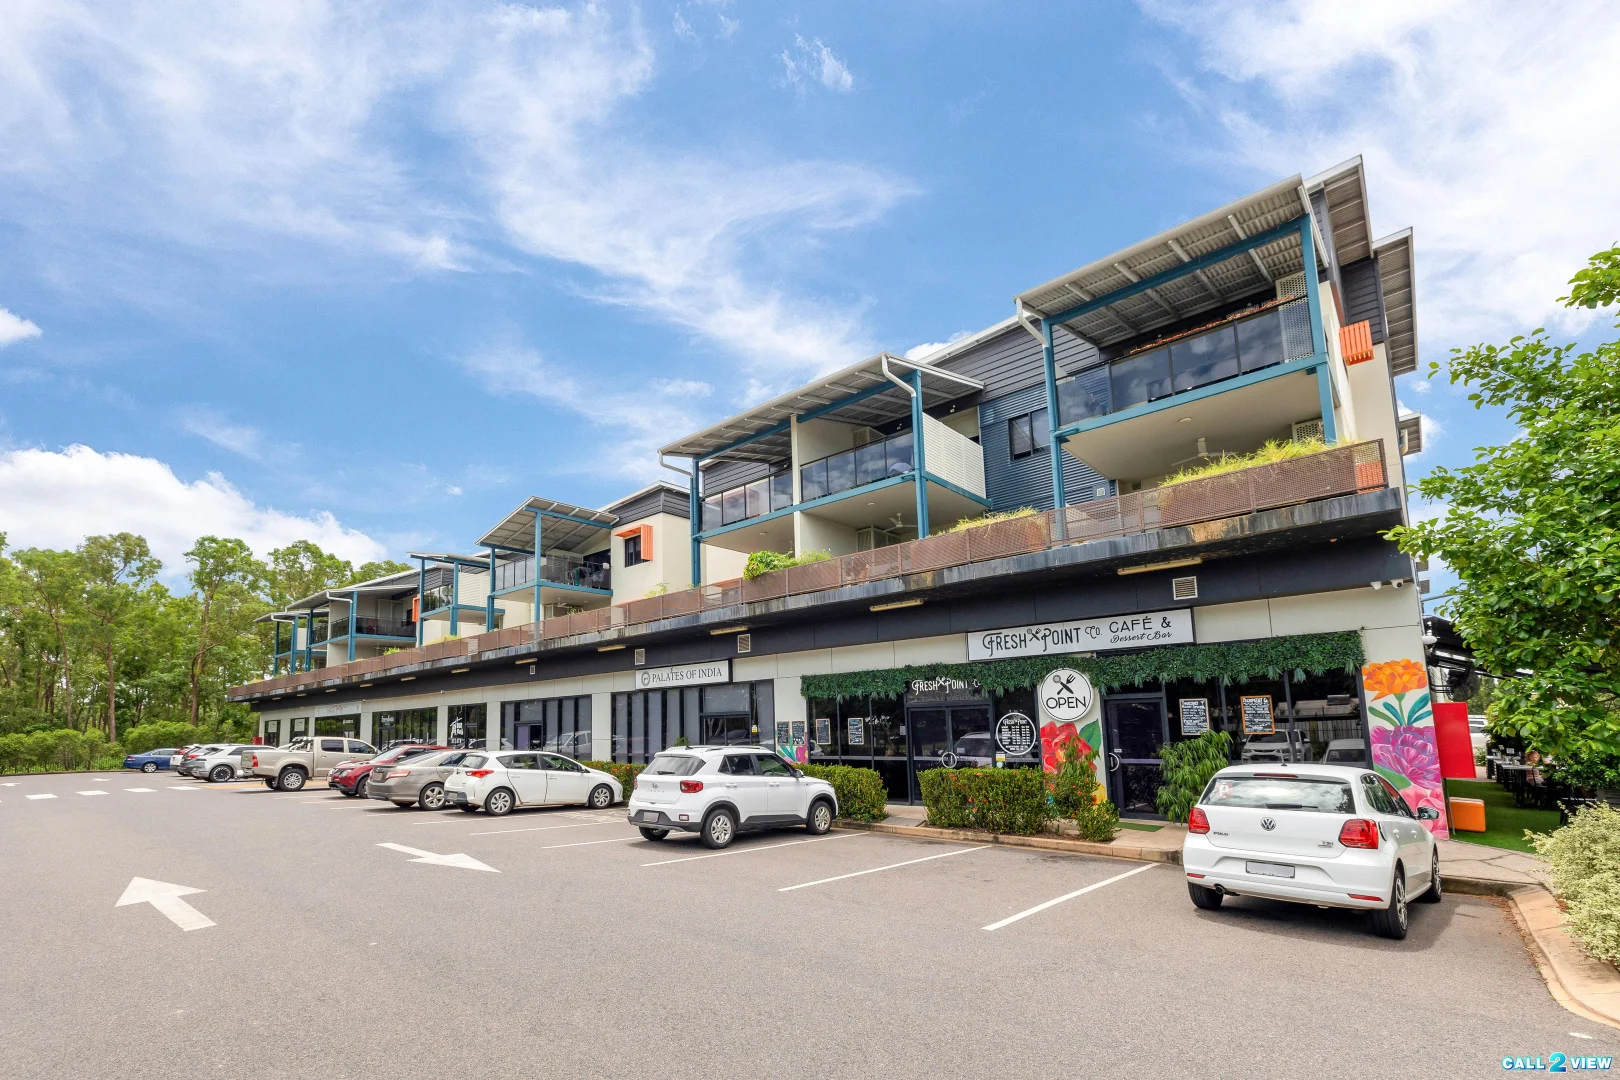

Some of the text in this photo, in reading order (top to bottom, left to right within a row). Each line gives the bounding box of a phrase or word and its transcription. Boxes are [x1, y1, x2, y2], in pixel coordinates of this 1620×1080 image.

[982, 632, 1027, 657] FRESH
[1041, 627, 1081, 652] POINT
[1109, 615, 1153, 633] CAFÉ
[1161, 616, 1172, 628] &
[1110, 631, 1173, 643] Dessert Bar
[652, 670, 684, 682] PALATES
[685, 669, 697, 680] OF
[698, 667, 723, 678] INDIA
[911, 679, 938, 695] FRESH
[1046, 696, 1087, 709] OPEN
